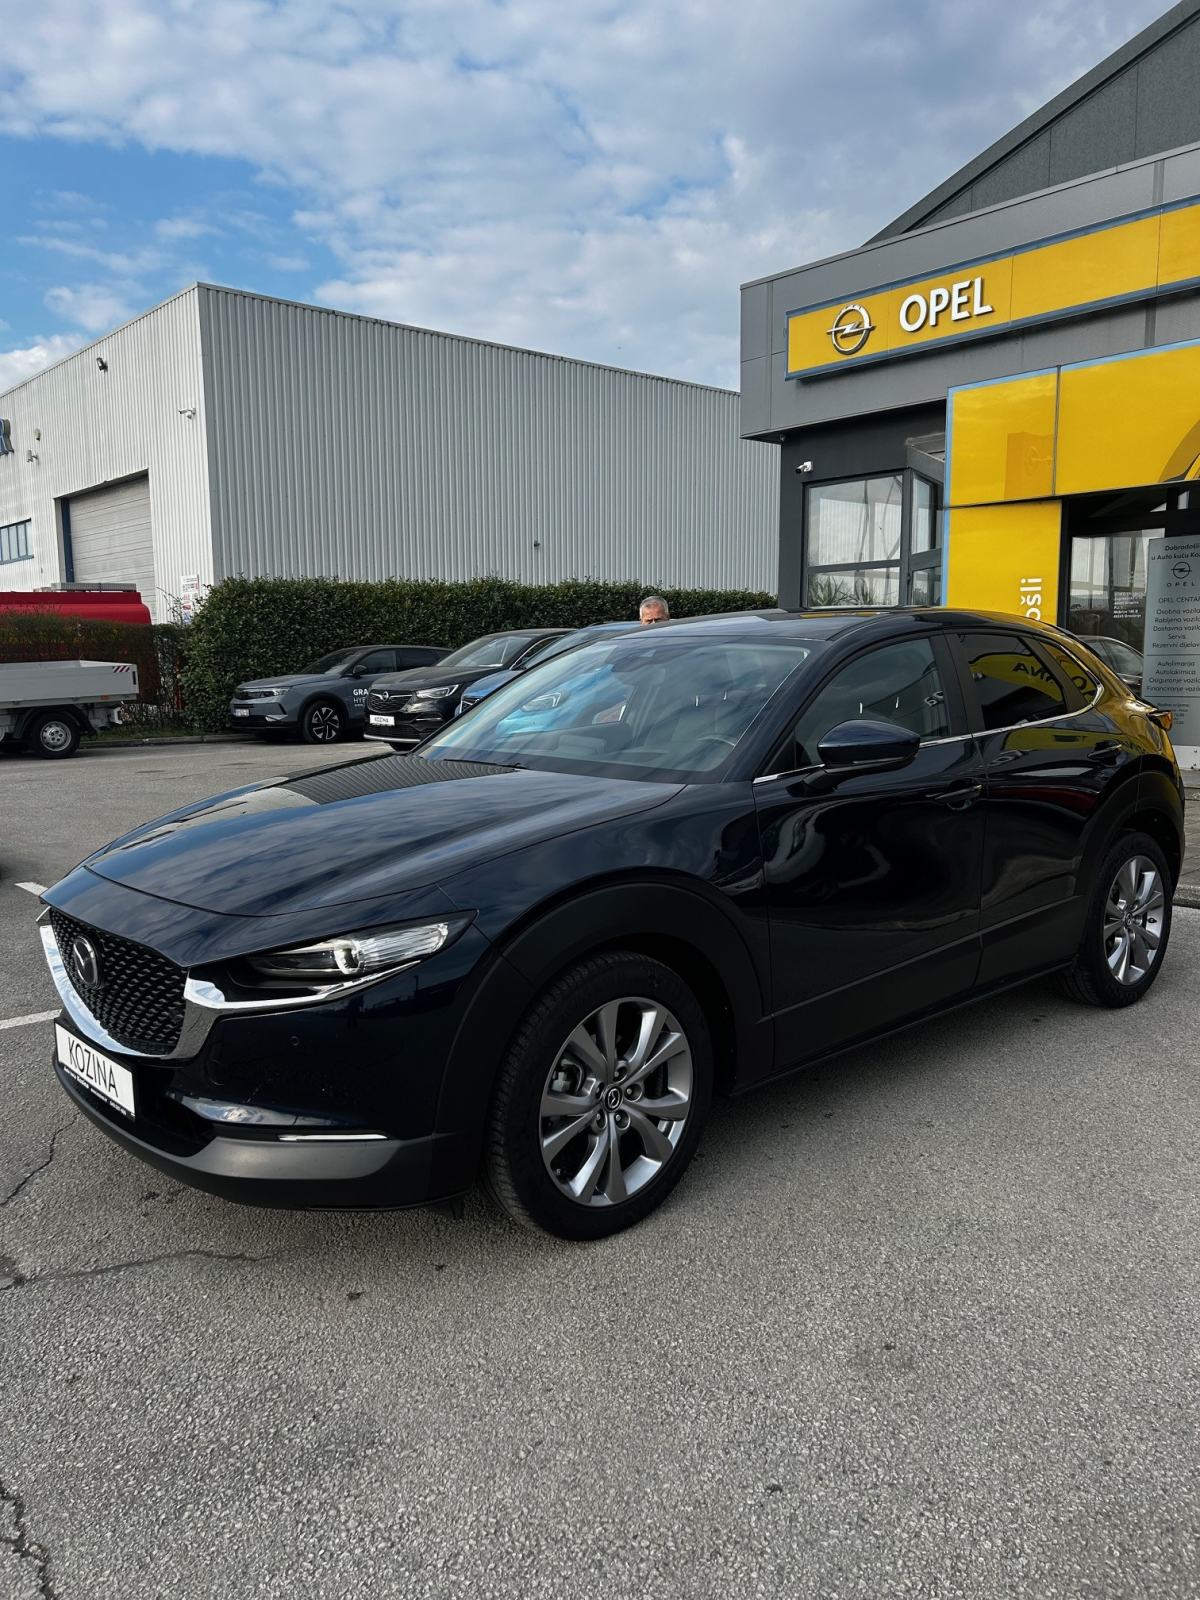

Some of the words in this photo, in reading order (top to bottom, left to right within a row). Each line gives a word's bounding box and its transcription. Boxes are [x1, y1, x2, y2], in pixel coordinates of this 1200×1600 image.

[899, 276, 994, 333] OPEL
[1020, 578, 1042, 620] ošli
[1179, 641, 1200, 649] dijelov
[67, 1036, 119, 1098] KOZINA
